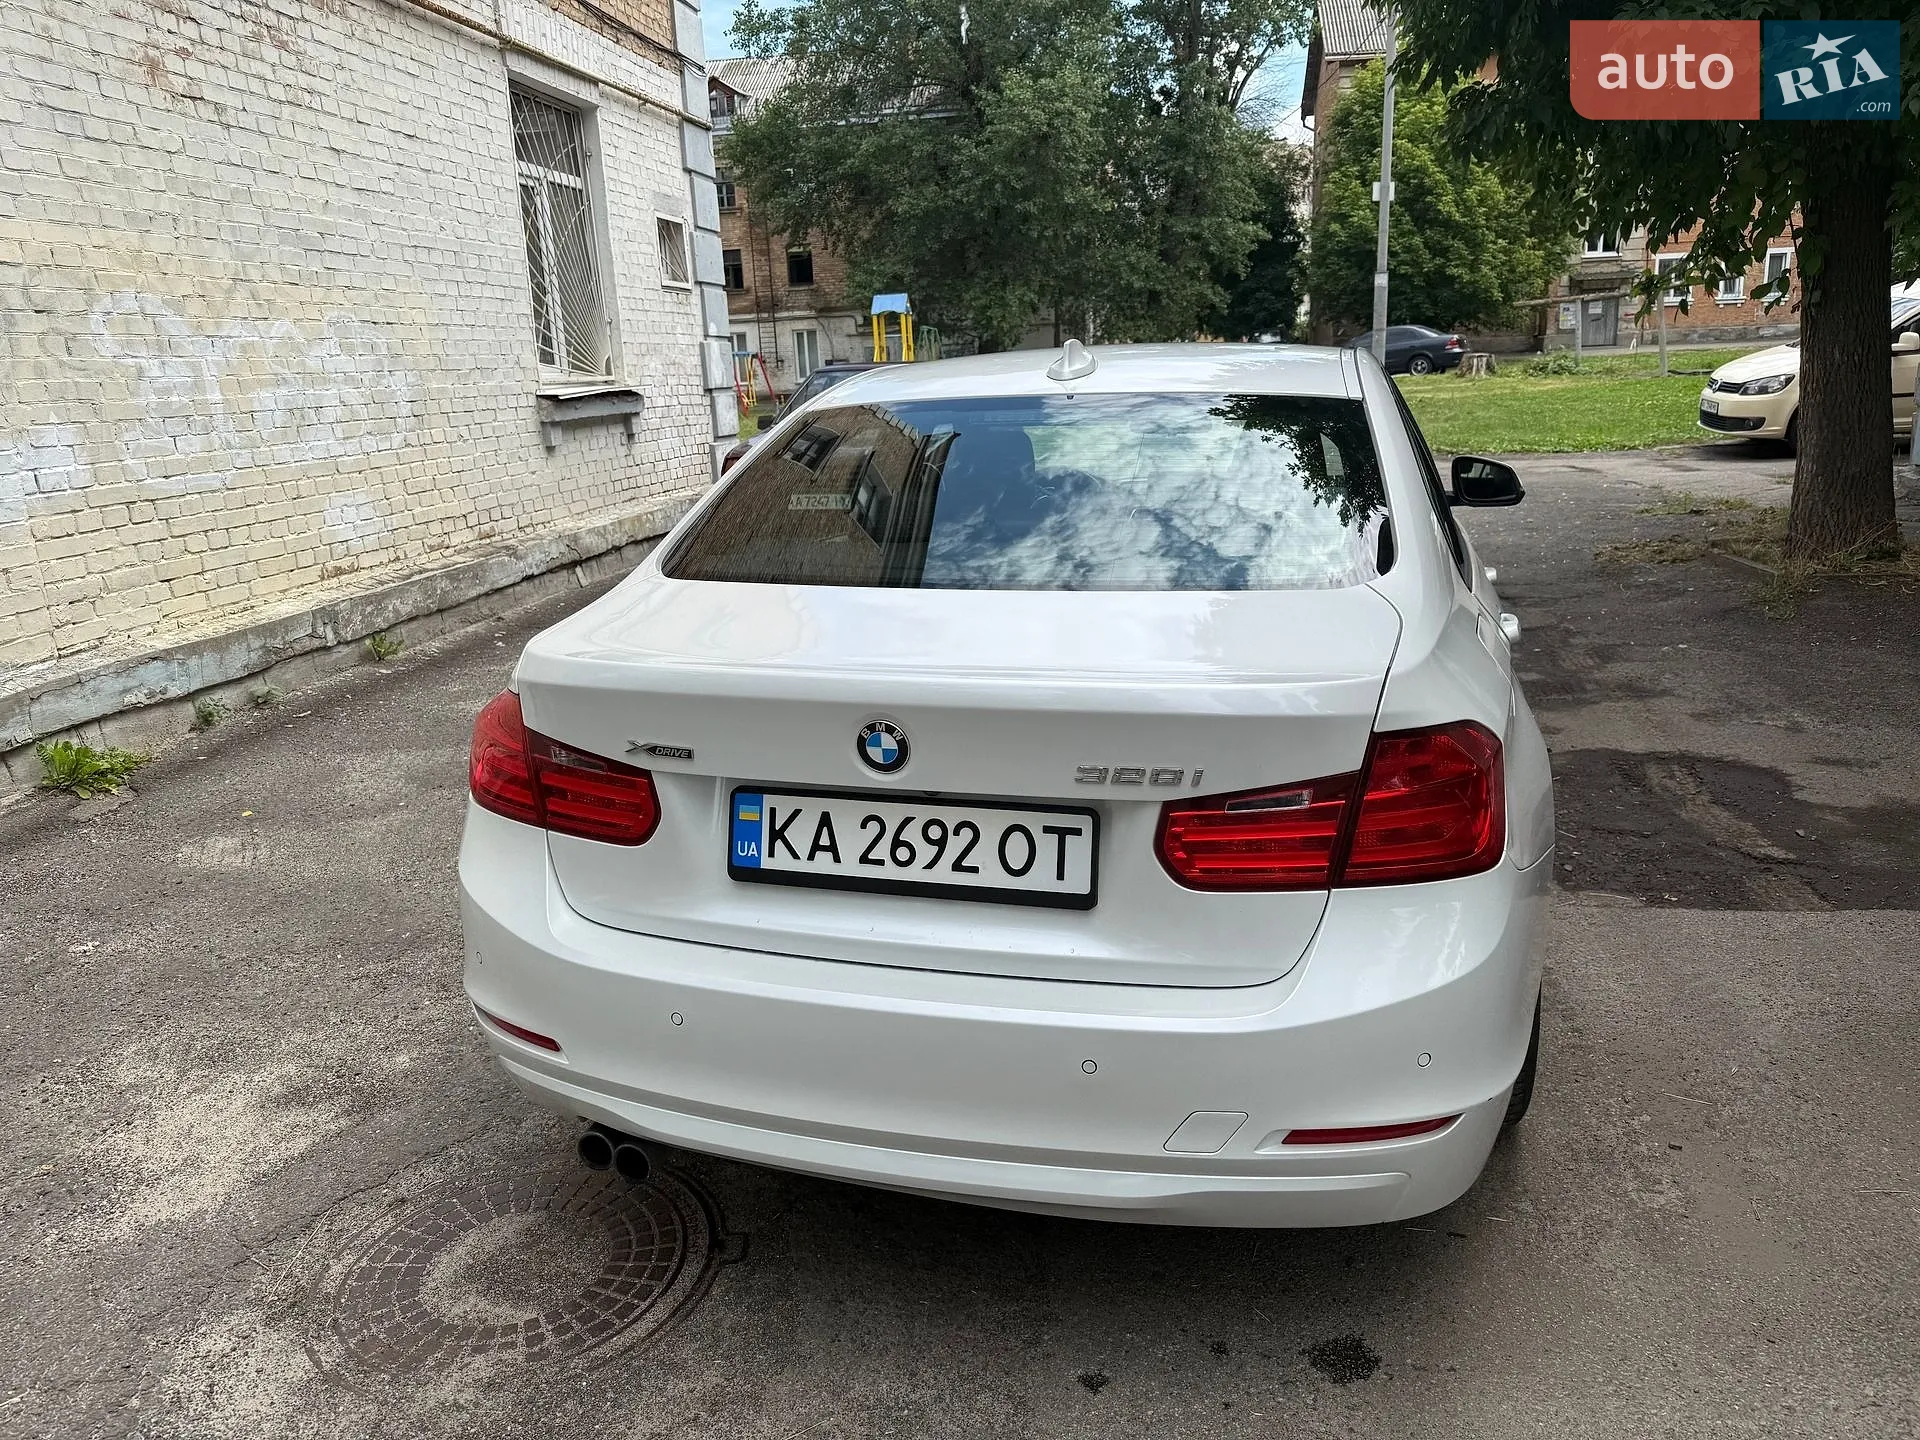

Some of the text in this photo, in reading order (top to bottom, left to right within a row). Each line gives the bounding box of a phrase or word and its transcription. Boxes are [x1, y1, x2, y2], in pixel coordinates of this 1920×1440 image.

[861, 723, 903, 740] BMW
[737, 840, 758, 857] UA
[768, 806, 1083, 881] KA 2692 OT
